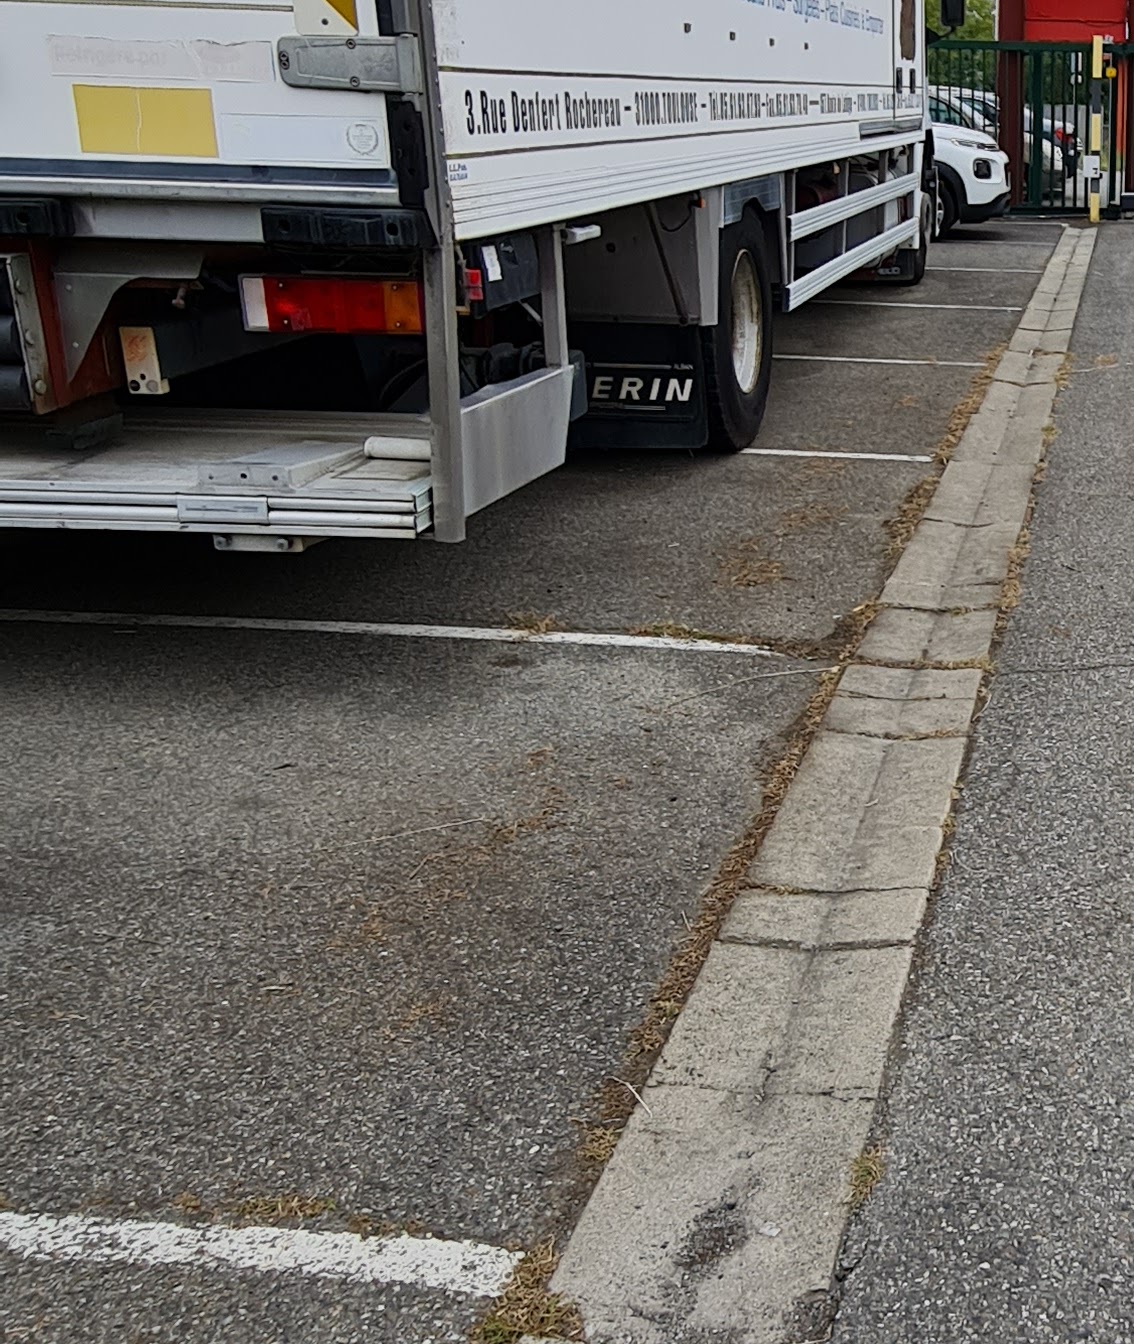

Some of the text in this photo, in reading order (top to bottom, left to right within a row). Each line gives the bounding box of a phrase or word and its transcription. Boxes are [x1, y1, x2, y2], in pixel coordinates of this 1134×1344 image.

[465, 89, 507, 135] 3.Rue
[511, 90, 561, 133] Denfert
[564, 91, 621, 130] Rochereau
[592, 376, 693, 401] ERIN
